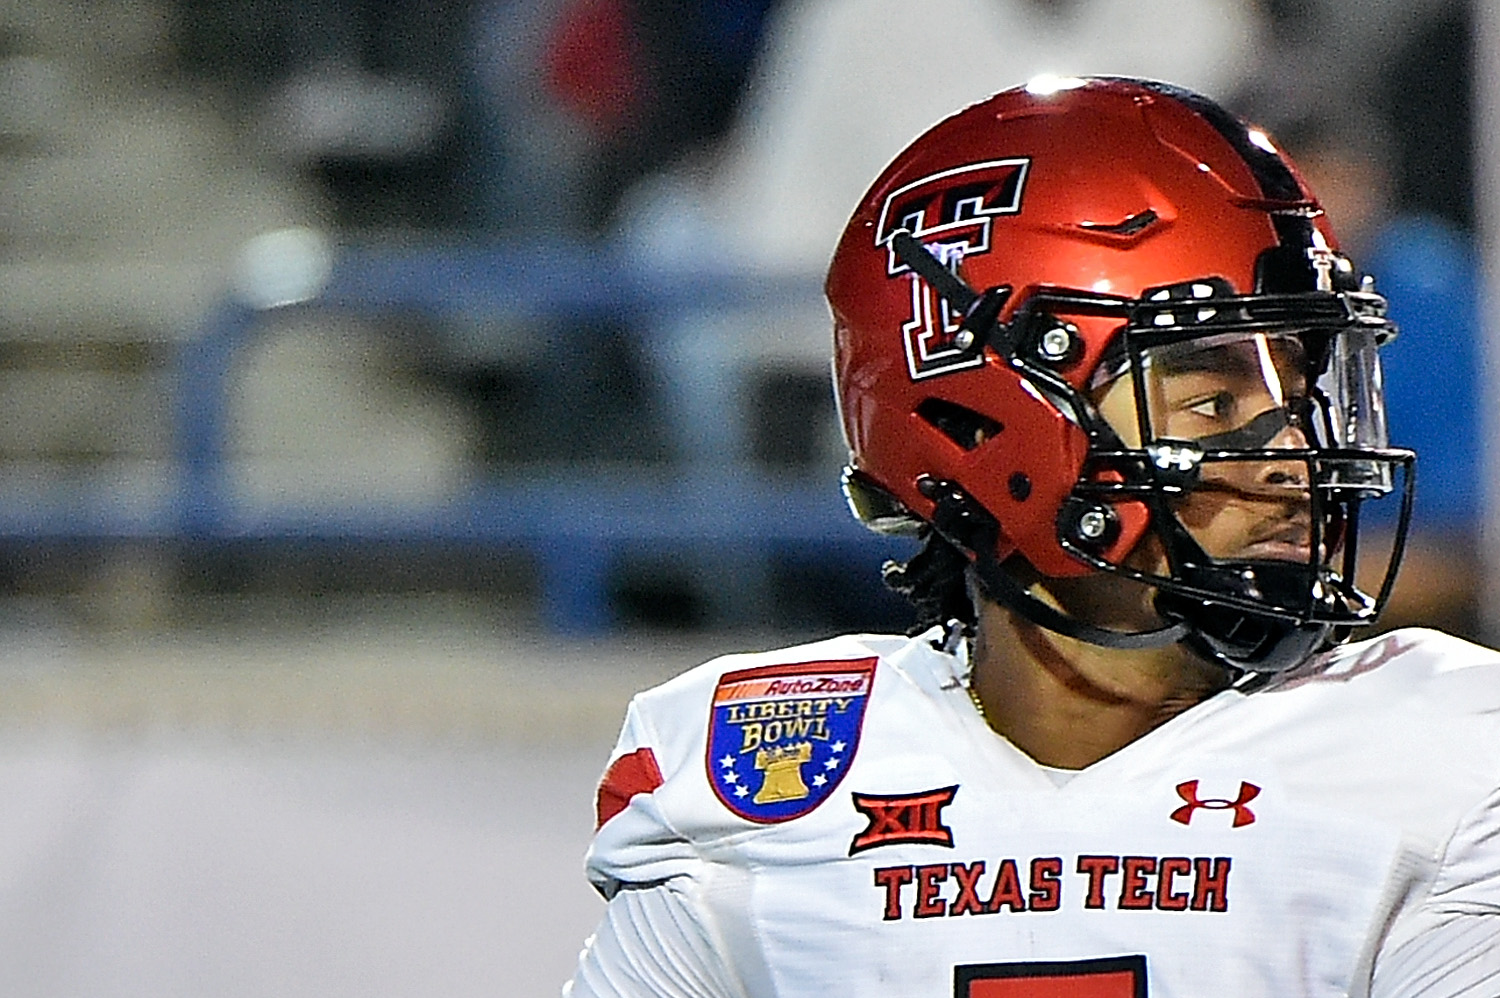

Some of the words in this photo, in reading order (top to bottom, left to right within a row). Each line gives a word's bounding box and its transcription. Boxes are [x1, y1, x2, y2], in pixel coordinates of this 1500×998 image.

[765, 677, 864, 697] AutoZone
[727, 698, 853, 723] LIBERTY
[739, 717, 830, 754] BOWL
[873, 857, 1063, 921] TEXAS
[1077, 855, 1232, 913] TECH
